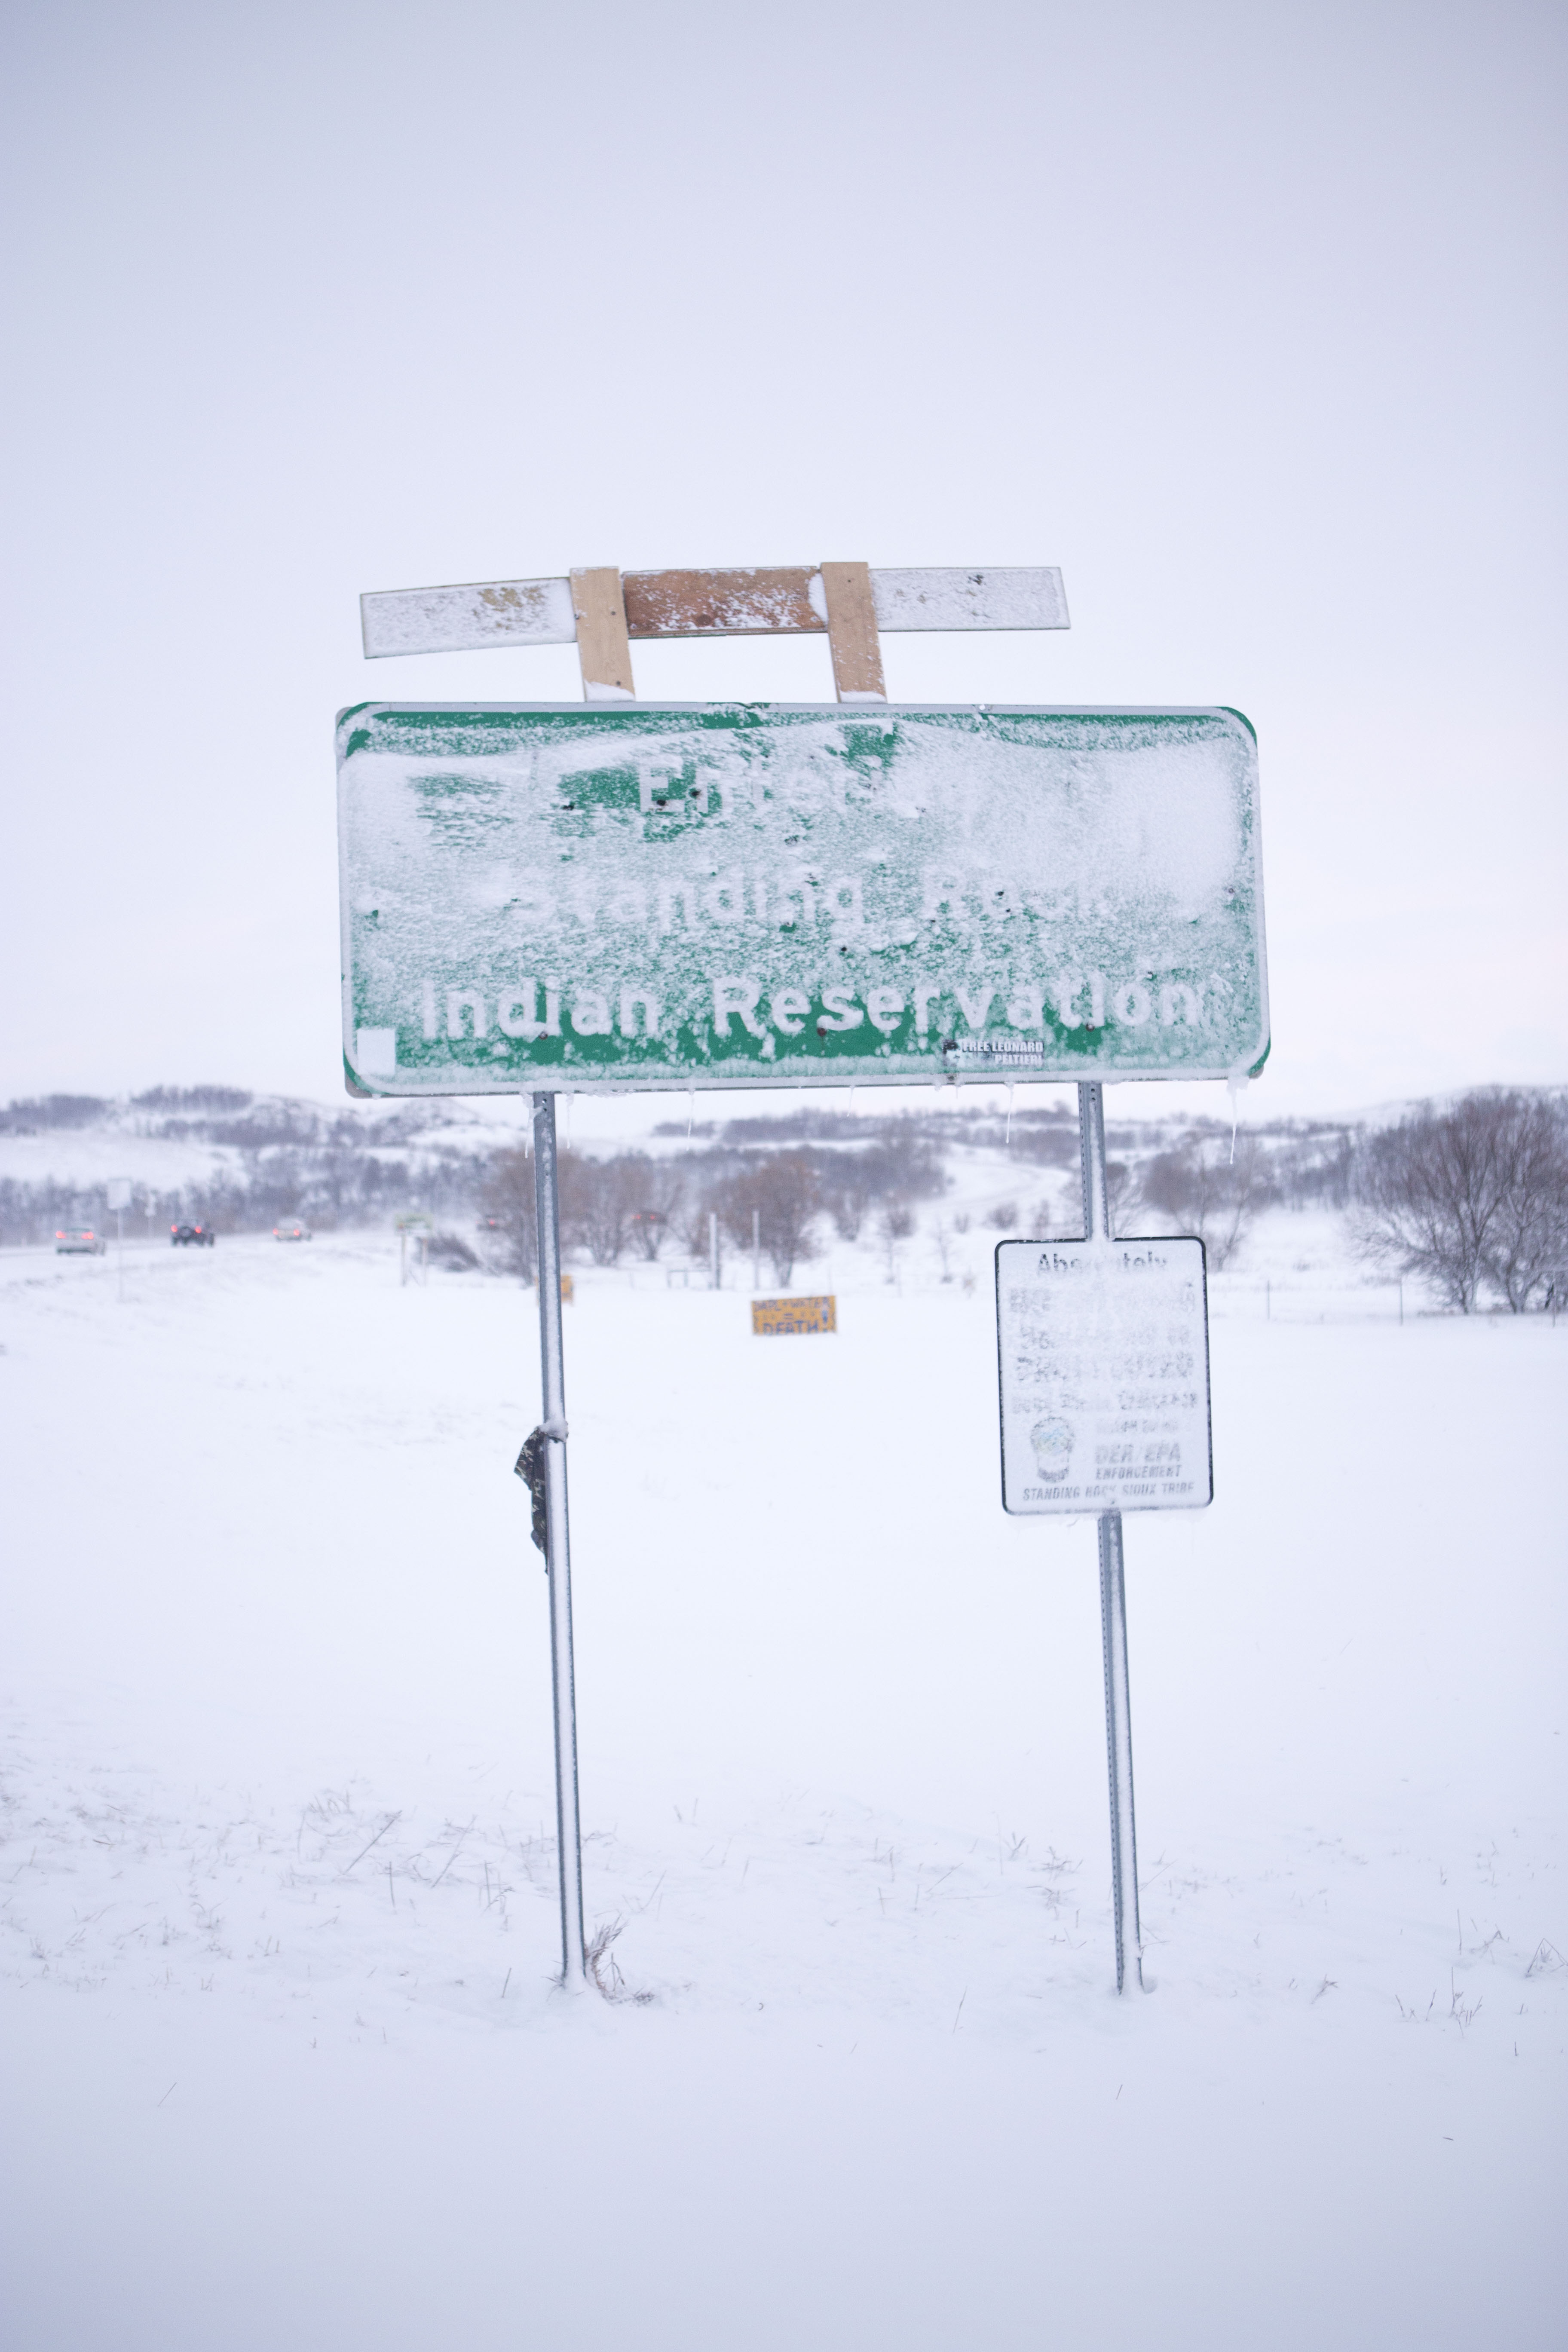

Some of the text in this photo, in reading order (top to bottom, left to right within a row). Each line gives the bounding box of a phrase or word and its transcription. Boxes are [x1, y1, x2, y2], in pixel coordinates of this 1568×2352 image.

[423, 972, 1200, 1038] Indian Reservation
[962, 1041, 1044, 1053] FREE LEONARD
[1037, 1251, 1167, 1272] Abtely
[1144, 1440, 1181, 1462] EPA
[1095, 1465, 1182, 1480] ENFORCEMENT
[1023, 1488, 1081, 1501] STANDING
[1121, 1483, 1157, 1496] SIOUX
[1162, 1482, 1194, 1495] TRIBE
